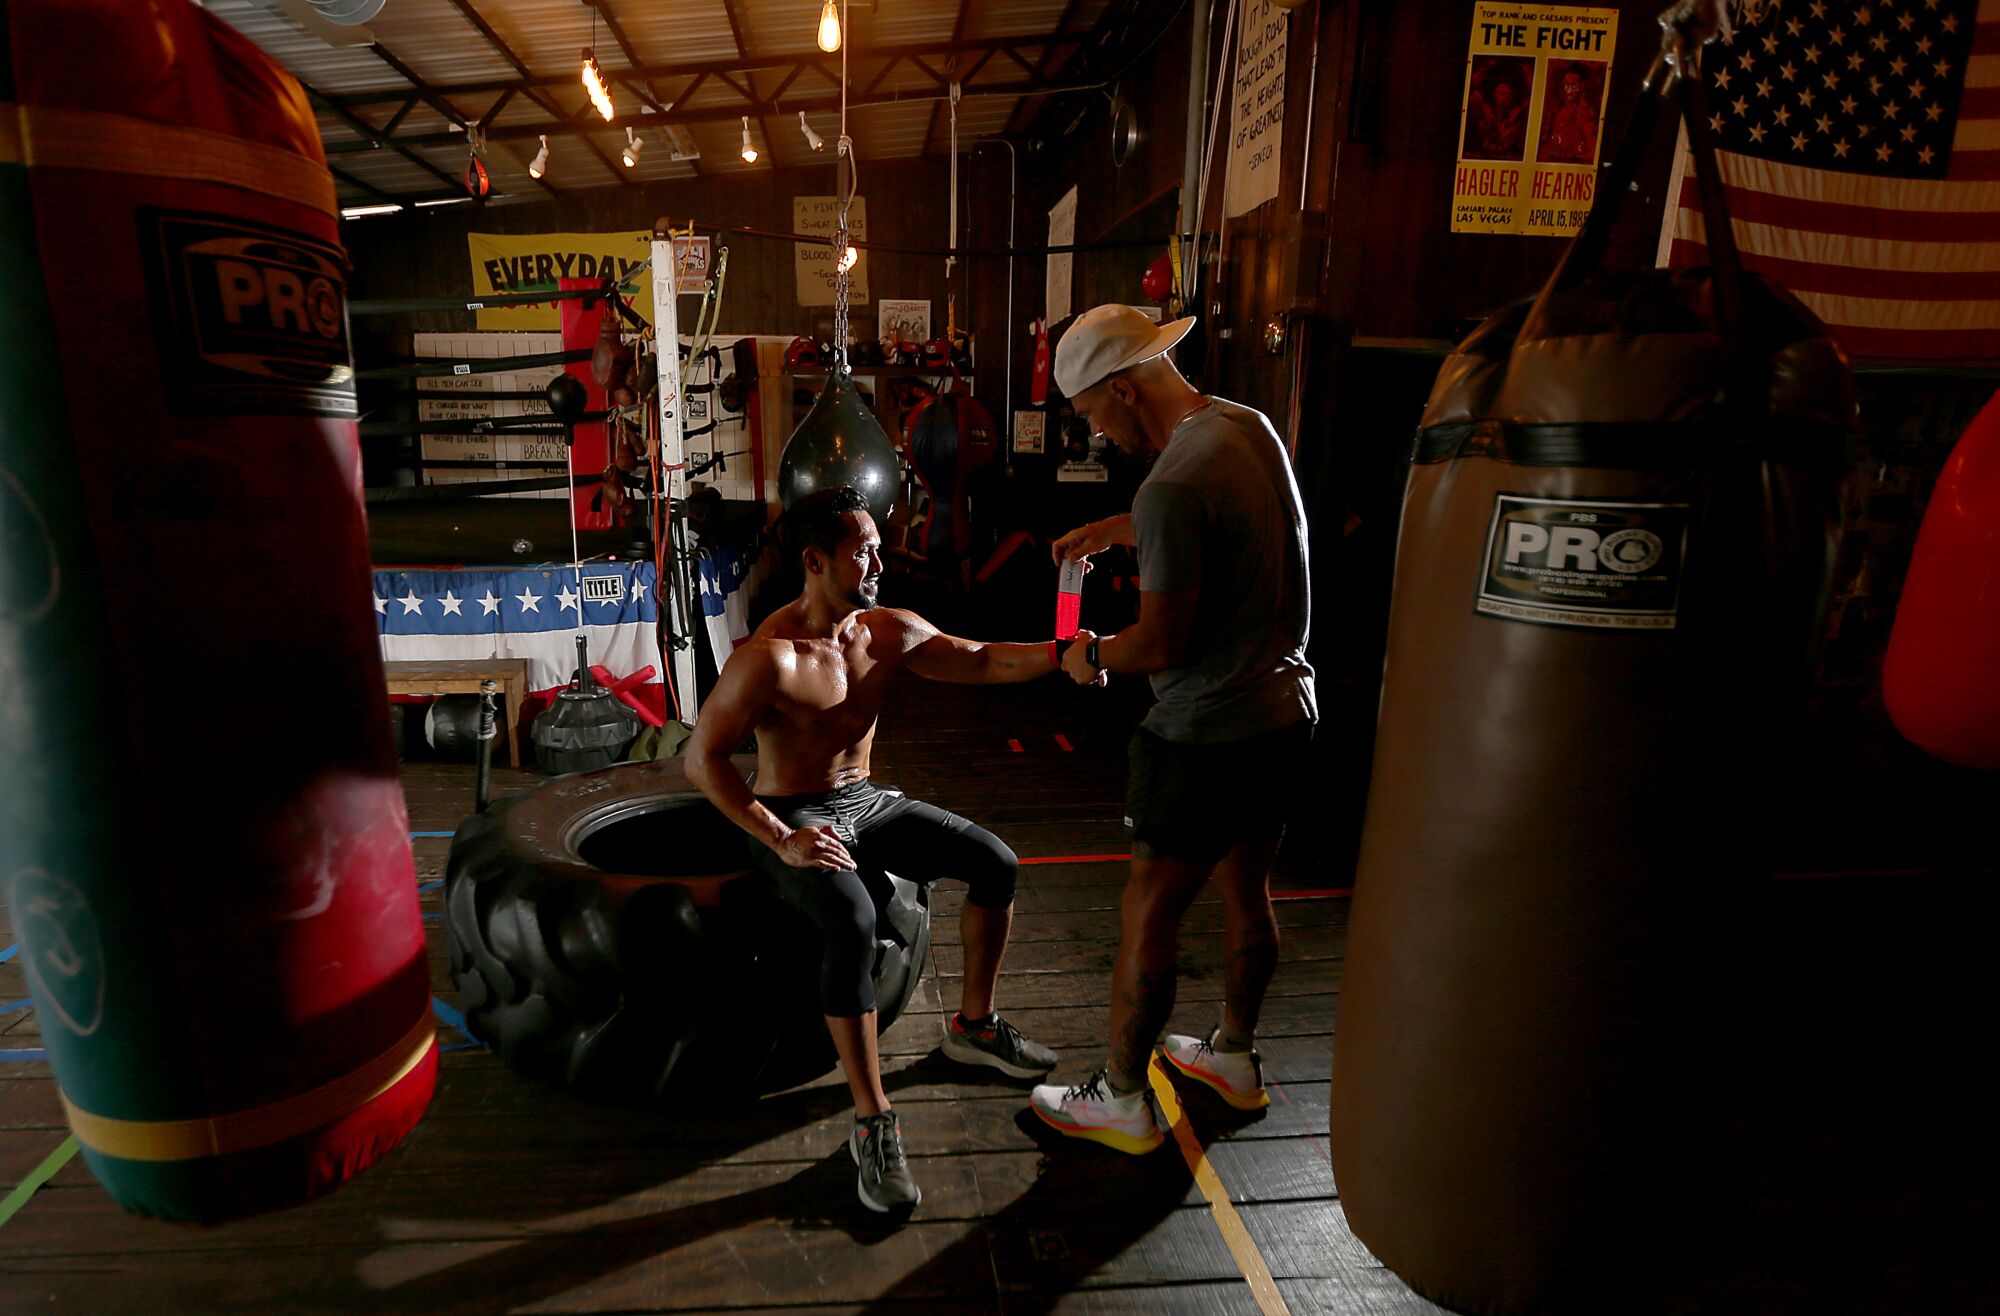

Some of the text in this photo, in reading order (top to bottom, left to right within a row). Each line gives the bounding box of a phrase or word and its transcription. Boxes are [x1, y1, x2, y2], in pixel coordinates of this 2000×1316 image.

[1482, 10, 1610, 25] TOP RANK AND CAESARS PRESENT
[1265, 12, 1286, 48] ROAD
[1480, 23, 1608, 51] THE FIGHT
[1237, 67, 1255, 96] THAT
[1255, 50, 1276, 81] LEADS
[1240, 97, 1252, 121] THE
[1236, 127, 1248, 149] OF
[1455, 168, 1594, 201] HAGLER HEARNS
[1456, 214, 1512, 225] LAS VEGAS
[1457, 205, 1513, 214] CAESARS PALACE
[1528, 208, 1555, 227] APRIL
[801, 219, 864, 229] SWEAT SVES
[483, 252, 643, 292] EVERYDAY
[214, 259, 342, 339] PRO
[455, 380, 468, 388] CAN
[523, 444, 553, 460] BREAK
[1570, 513, 1598, 523] PBS
[1504, 521, 1664, 574] PRO
[586, 579, 618, 596] TITLE
[1479, 601, 1523, 616] CRAFTED
[1526, 607, 1556, 619] WITH
[1558, 610, 1595, 624] PRIDE
[1597, 615, 1610, 625] IN
[1615, 616, 1642, 626] THE
